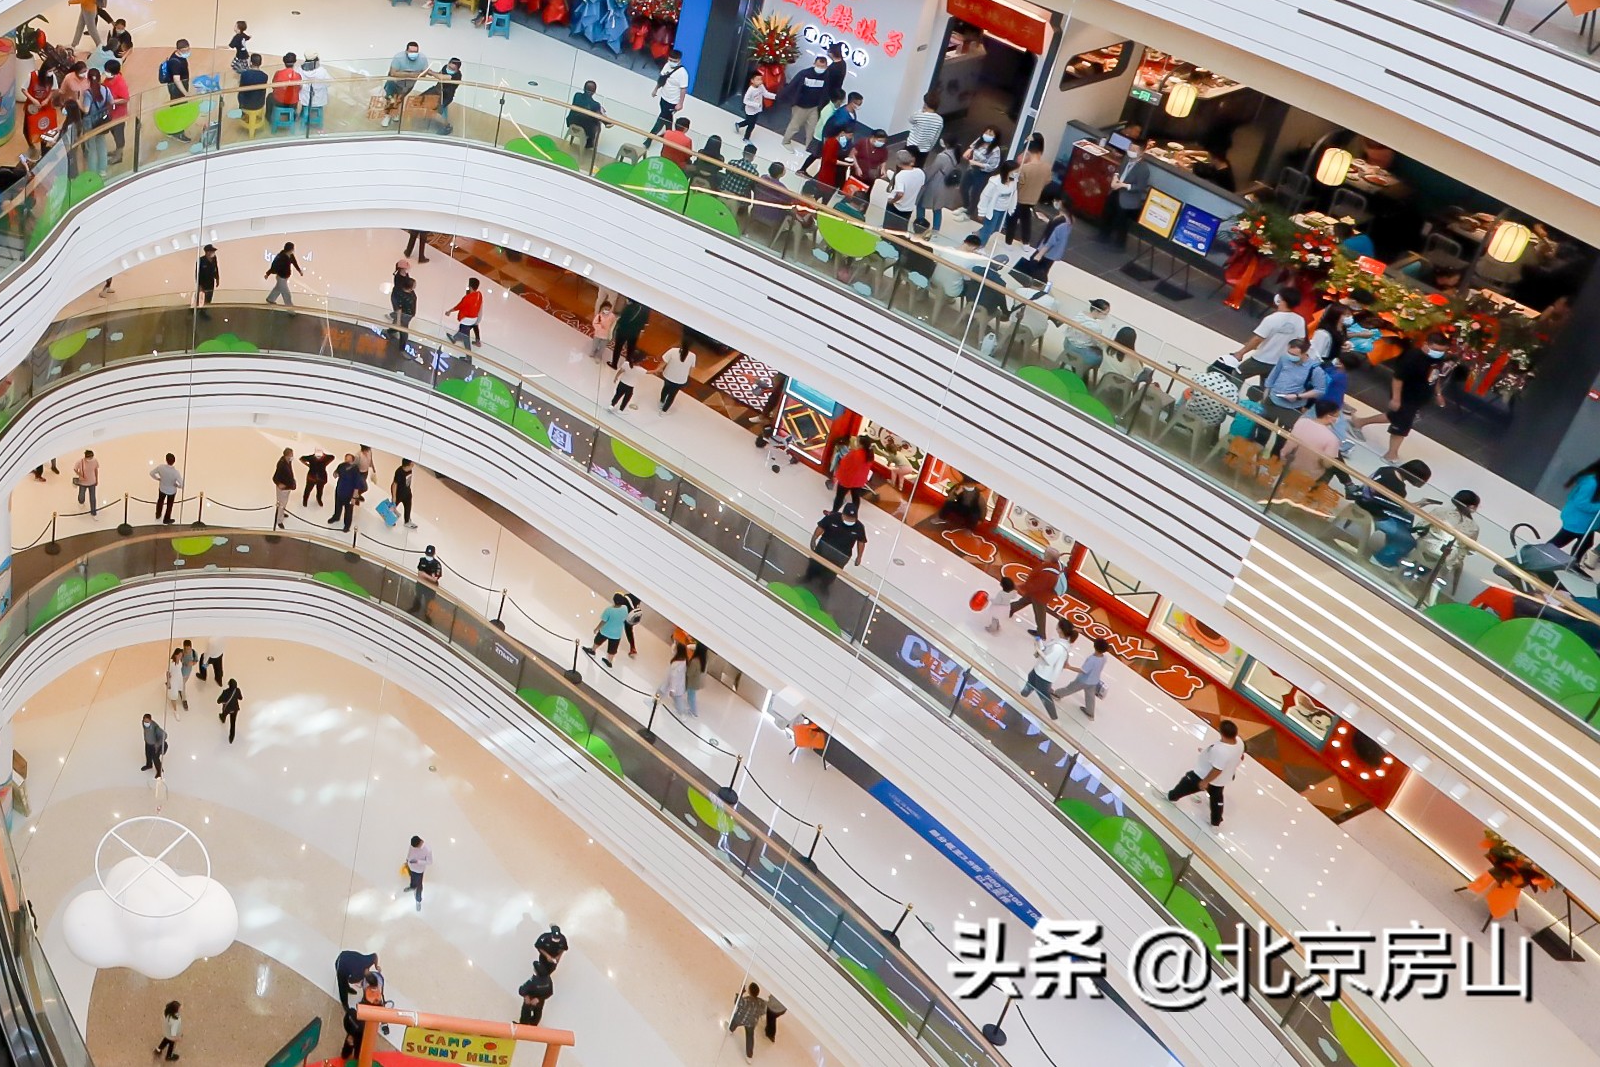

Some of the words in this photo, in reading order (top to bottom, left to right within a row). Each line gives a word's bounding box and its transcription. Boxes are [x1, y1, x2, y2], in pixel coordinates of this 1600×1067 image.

[647, 158, 664, 173] 向
[646, 172, 685, 191] YOUNG
[479, 387, 510, 409] YOUNG
[1000, 562, 1159, 662] CTOONY
[1529, 621, 1563, 650] 向
[1526, 635, 1598, 692] YOUNG
[1121, 818, 1143, 842] 向
[1120, 831, 1165, 878] YOUNG
[424, 1033, 472, 1048] CAMP
[406, 1041, 459, 1061] SUNNY
[466, 1051, 508, 1066] HILLS
